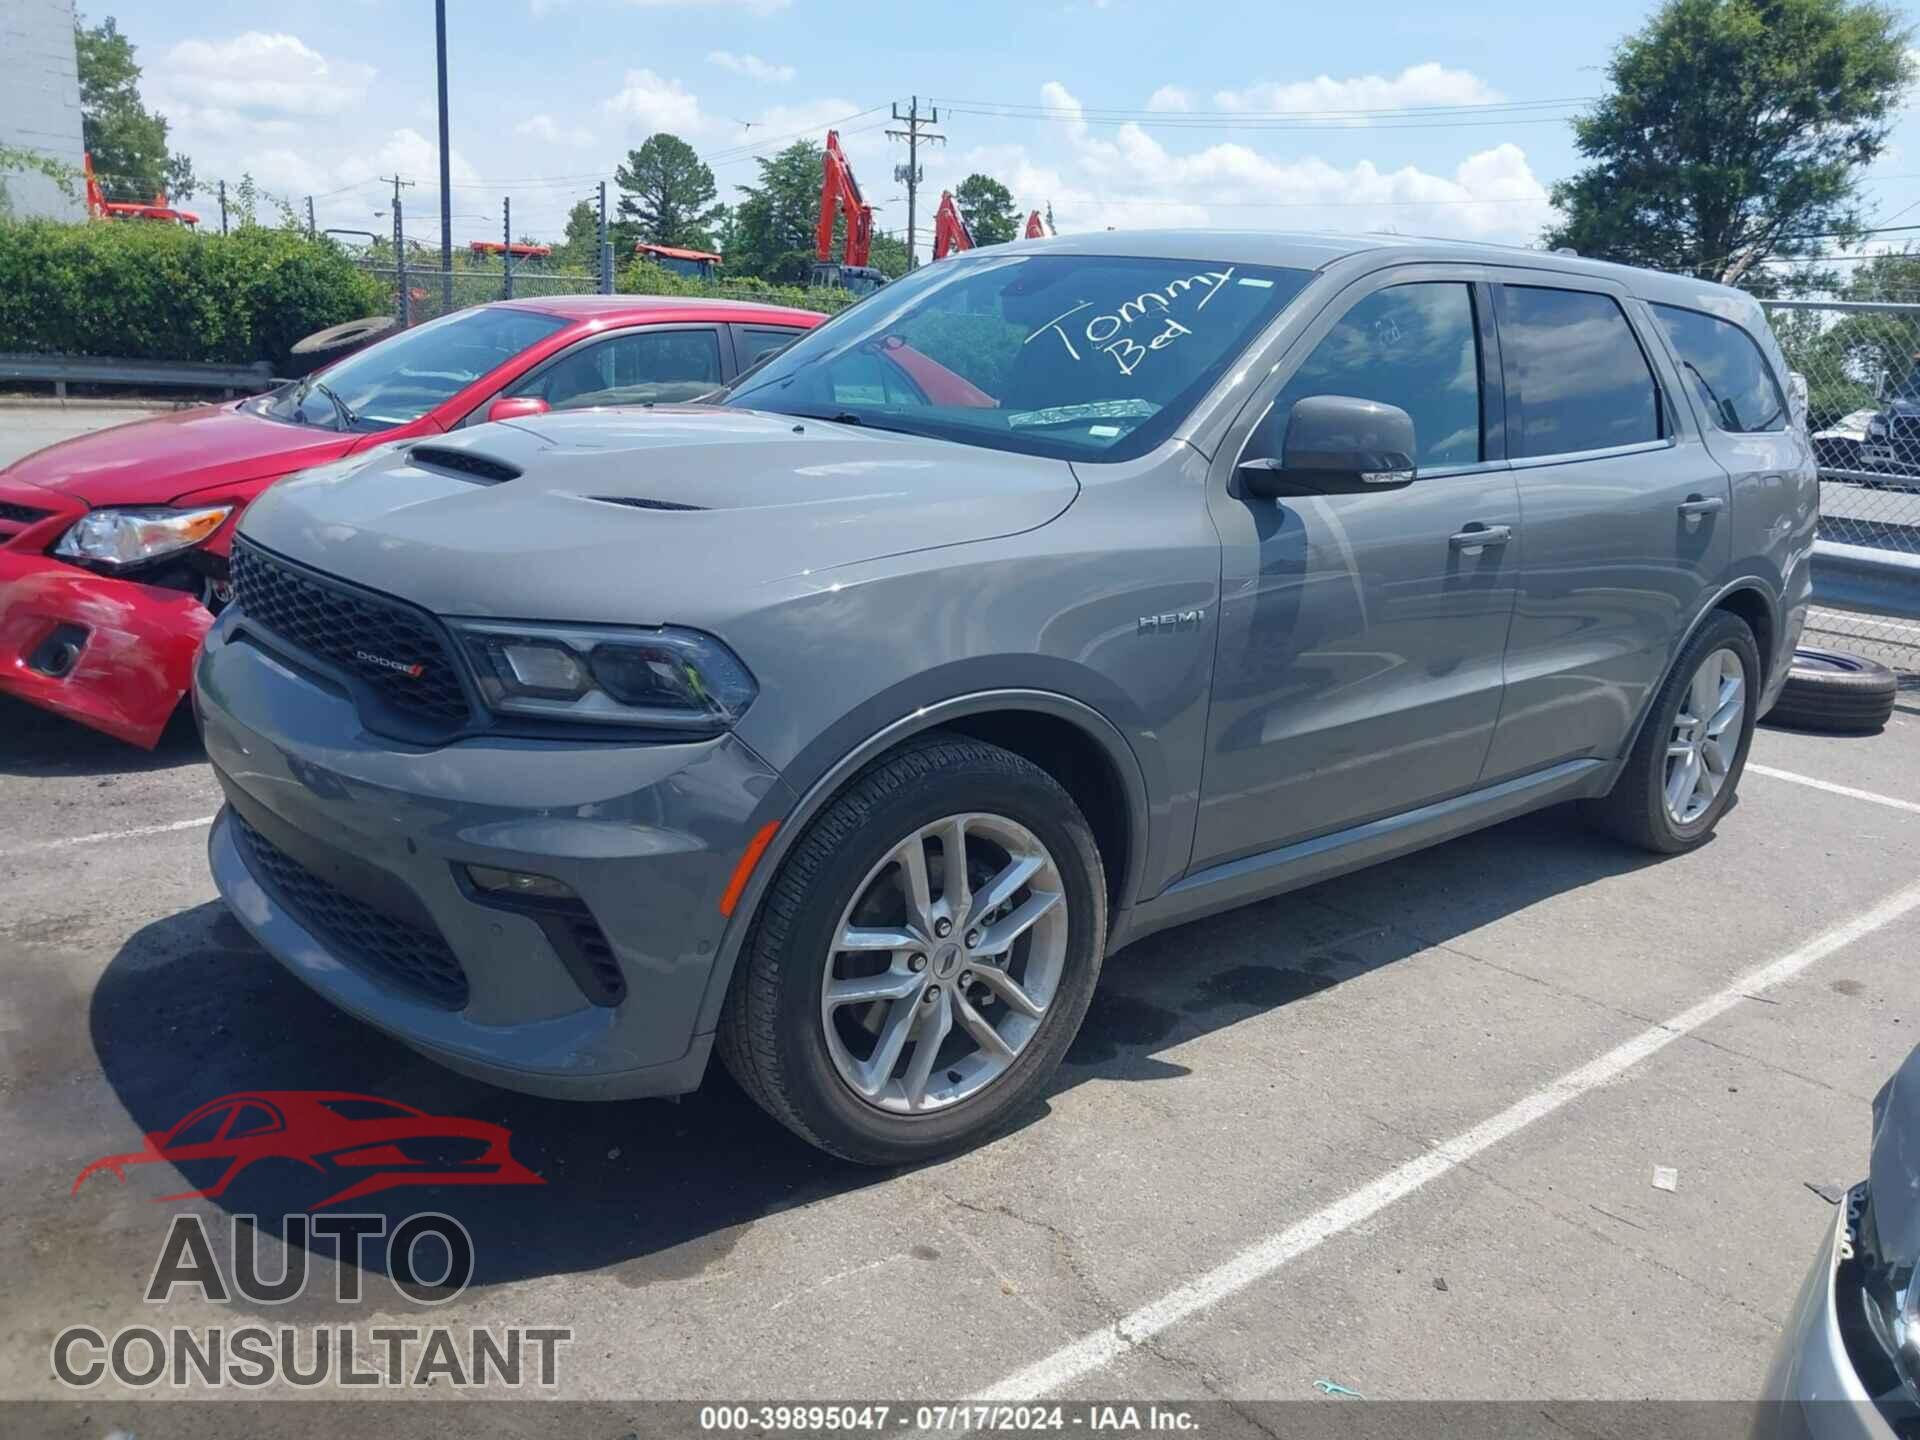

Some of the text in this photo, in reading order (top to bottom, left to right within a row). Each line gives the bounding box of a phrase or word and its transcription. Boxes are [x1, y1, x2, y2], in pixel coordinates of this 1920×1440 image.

[1024, 266, 1235, 360] Tommy
[1139, 609, 1205, 627] HEMI
[356, 650, 410, 673] DODGE
